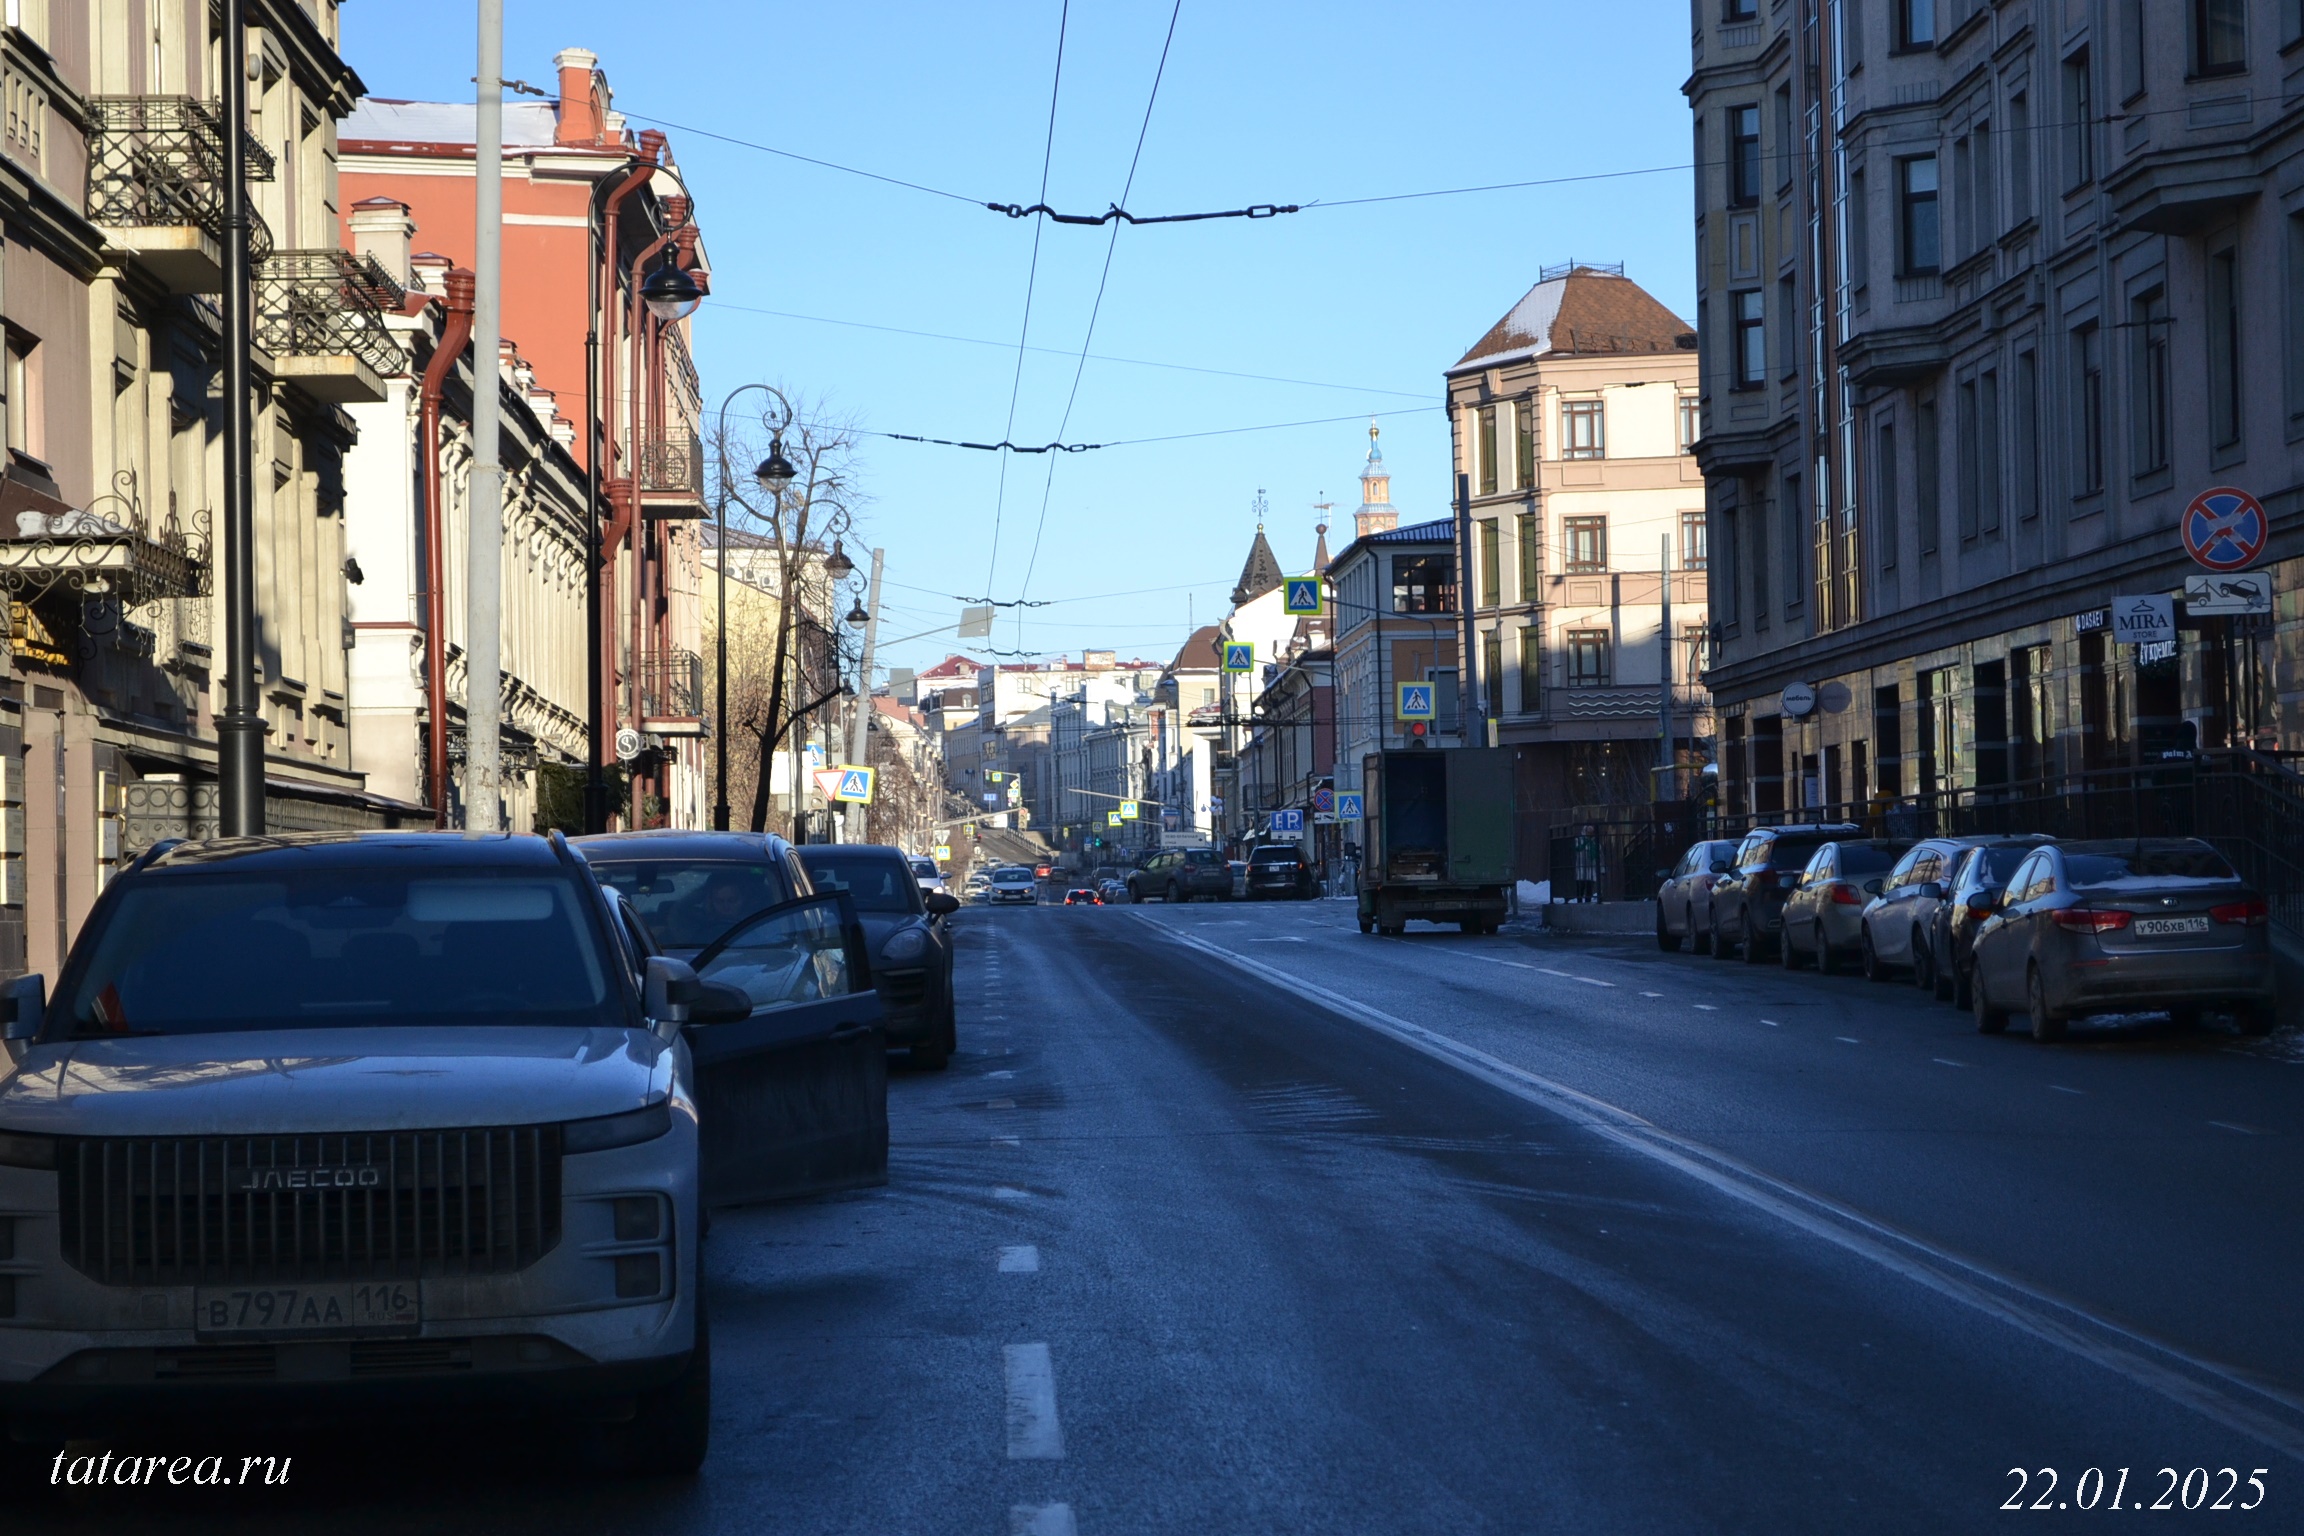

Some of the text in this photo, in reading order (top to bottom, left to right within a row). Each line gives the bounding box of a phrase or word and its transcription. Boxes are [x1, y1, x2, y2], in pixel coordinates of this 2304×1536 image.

[2119, 613, 2169, 631] MIRA
[2132, 630, 2158, 639] STORE
[1287, 812, 1299, 829] P
[2187, 918, 2205, 928] 116
[240, 1168, 379, 1189] JAECOO
[356, 1284, 409, 1312] 116
[367, 1311, 395, 1321] RUS
